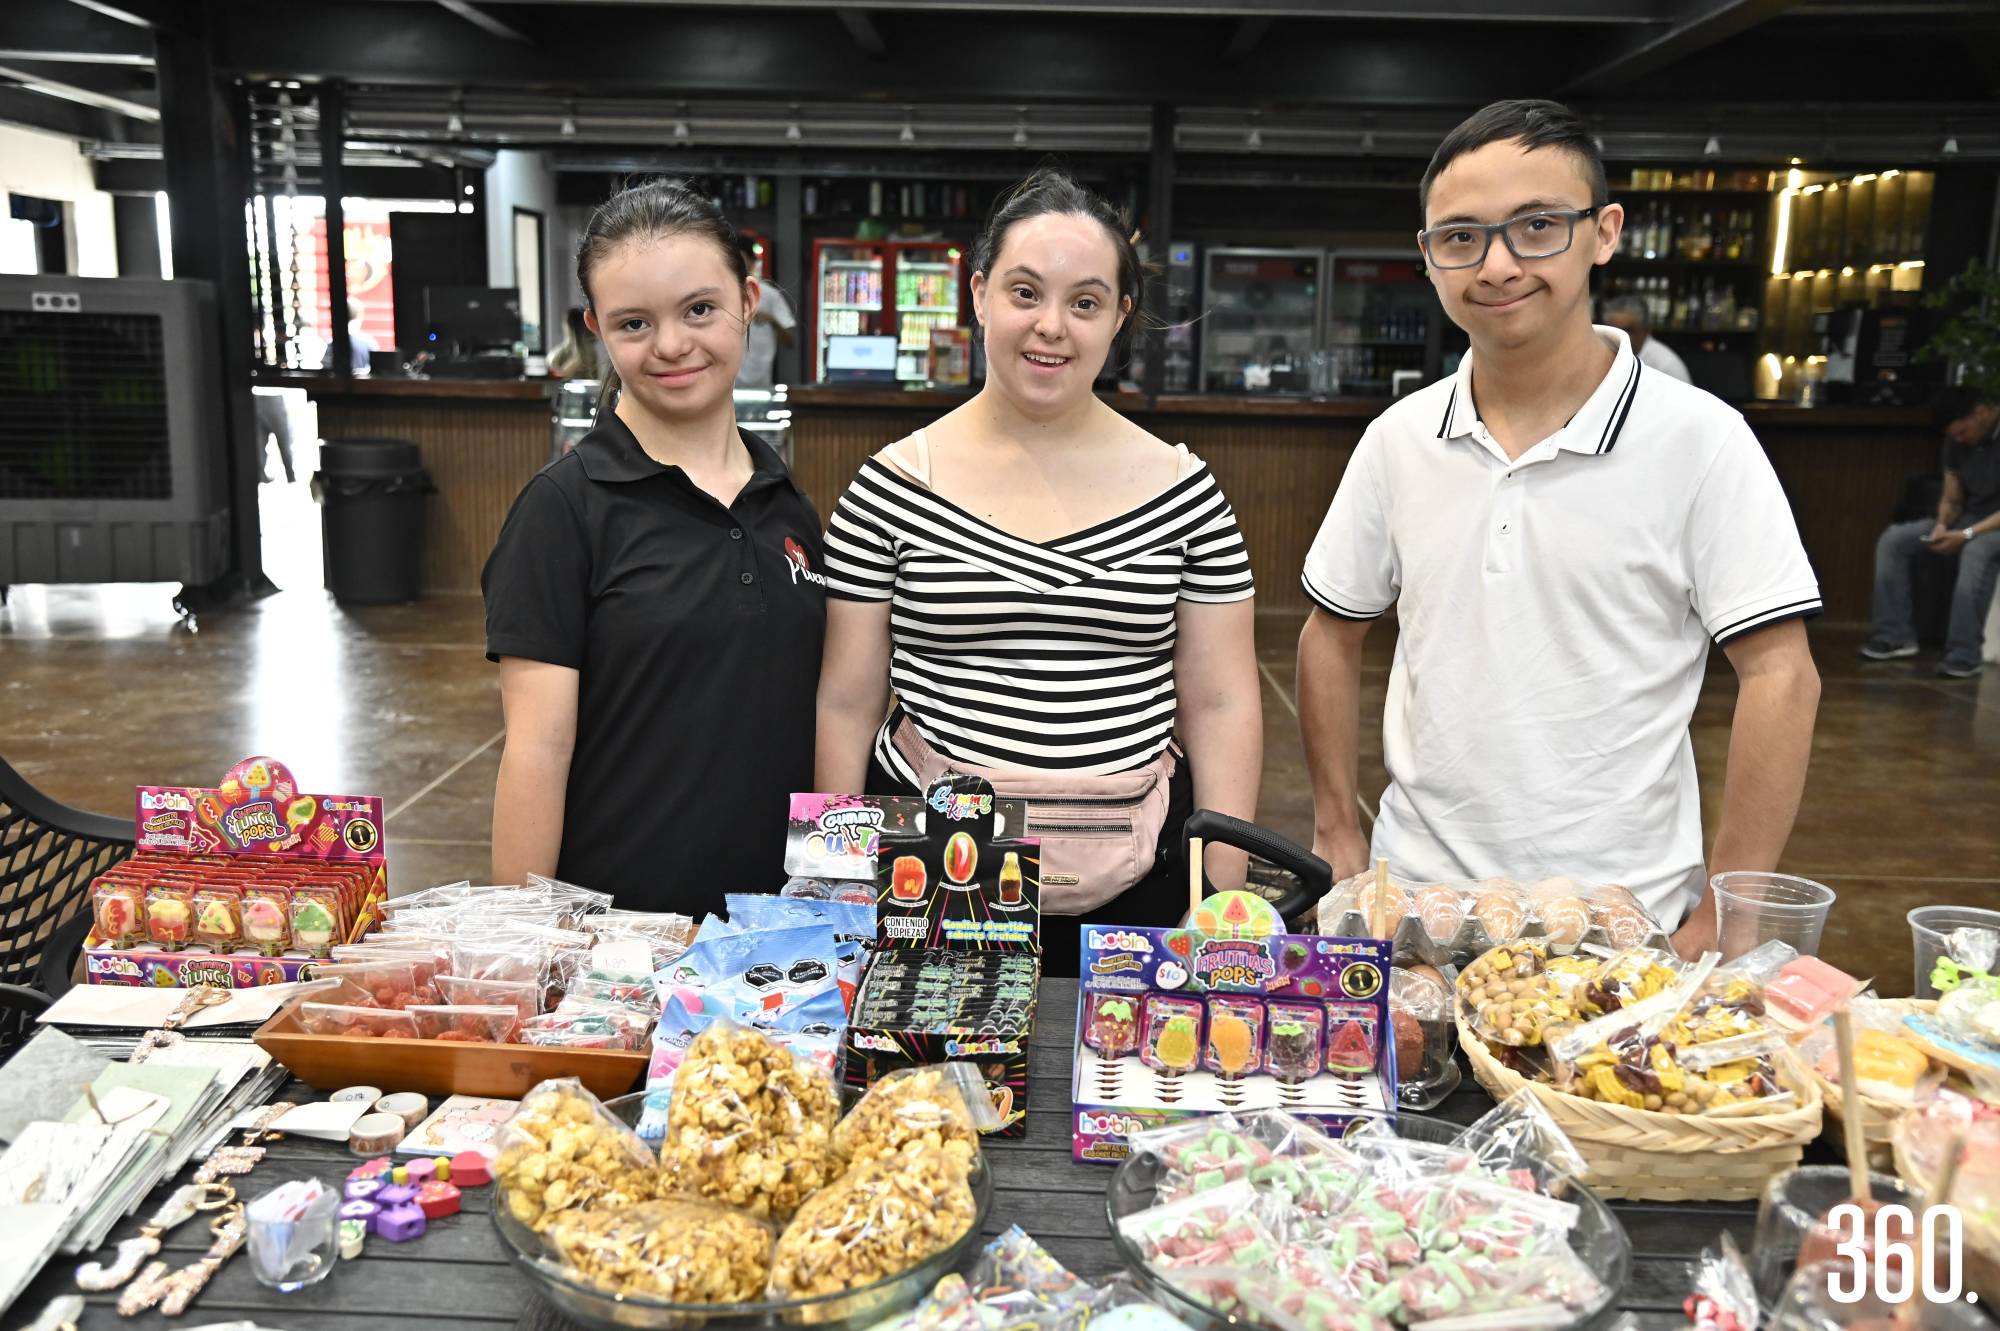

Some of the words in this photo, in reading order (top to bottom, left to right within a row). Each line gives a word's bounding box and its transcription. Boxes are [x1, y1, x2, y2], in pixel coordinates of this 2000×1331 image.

[142, 791, 190, 811] hobin
[234, 812, 277, 835] LUNCH
[823, 810, 881, 828] GUMMY
[885, 917, 928, 928] CONTENIDO
[1088, 930, 1151, 952] hobin
[88, 956, 140, 977] hobin
[187, 969, 231, 988] LUNCH
[1210, 967, 1257, 989] POP'S
[854, 1032, 899, 1052] hobin
